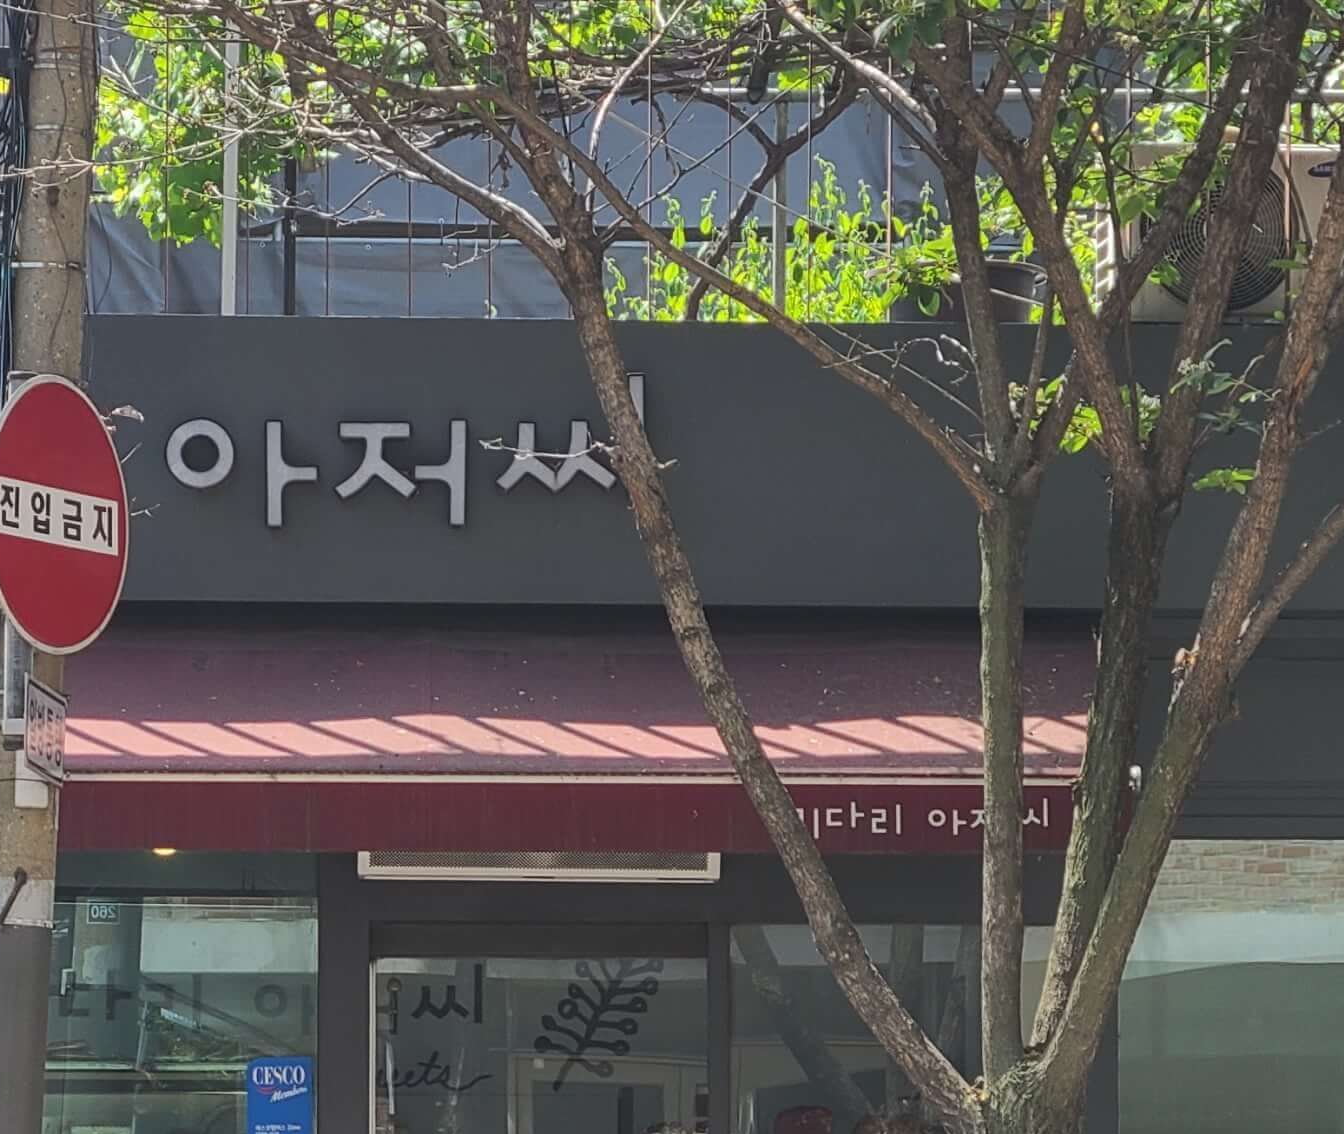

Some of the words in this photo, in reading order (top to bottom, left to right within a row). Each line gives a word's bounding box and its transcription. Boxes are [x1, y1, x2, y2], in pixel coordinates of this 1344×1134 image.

[164, 372, 646, 529] 아저씨
[0, 484, 113, 548] 진입금지
[252, 1065, 306, 1085] CESCO
